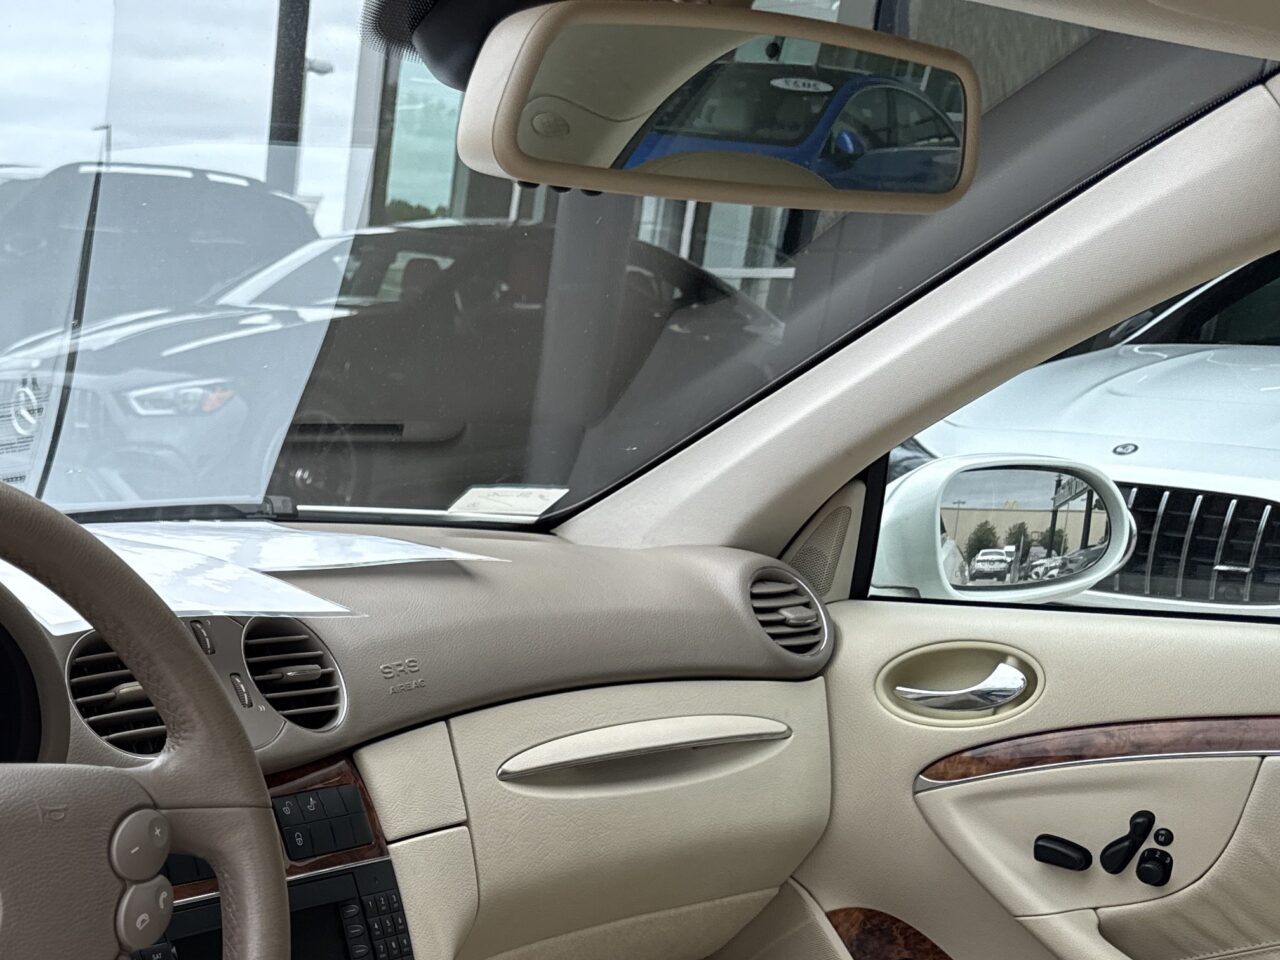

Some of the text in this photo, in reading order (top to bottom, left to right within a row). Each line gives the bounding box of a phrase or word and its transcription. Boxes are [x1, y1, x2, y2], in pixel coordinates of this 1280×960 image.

[379, 657, 420, 680] SRS
[389, 678, 426, 695] AIRBAG
[152, 952, 162, 960] SAT
